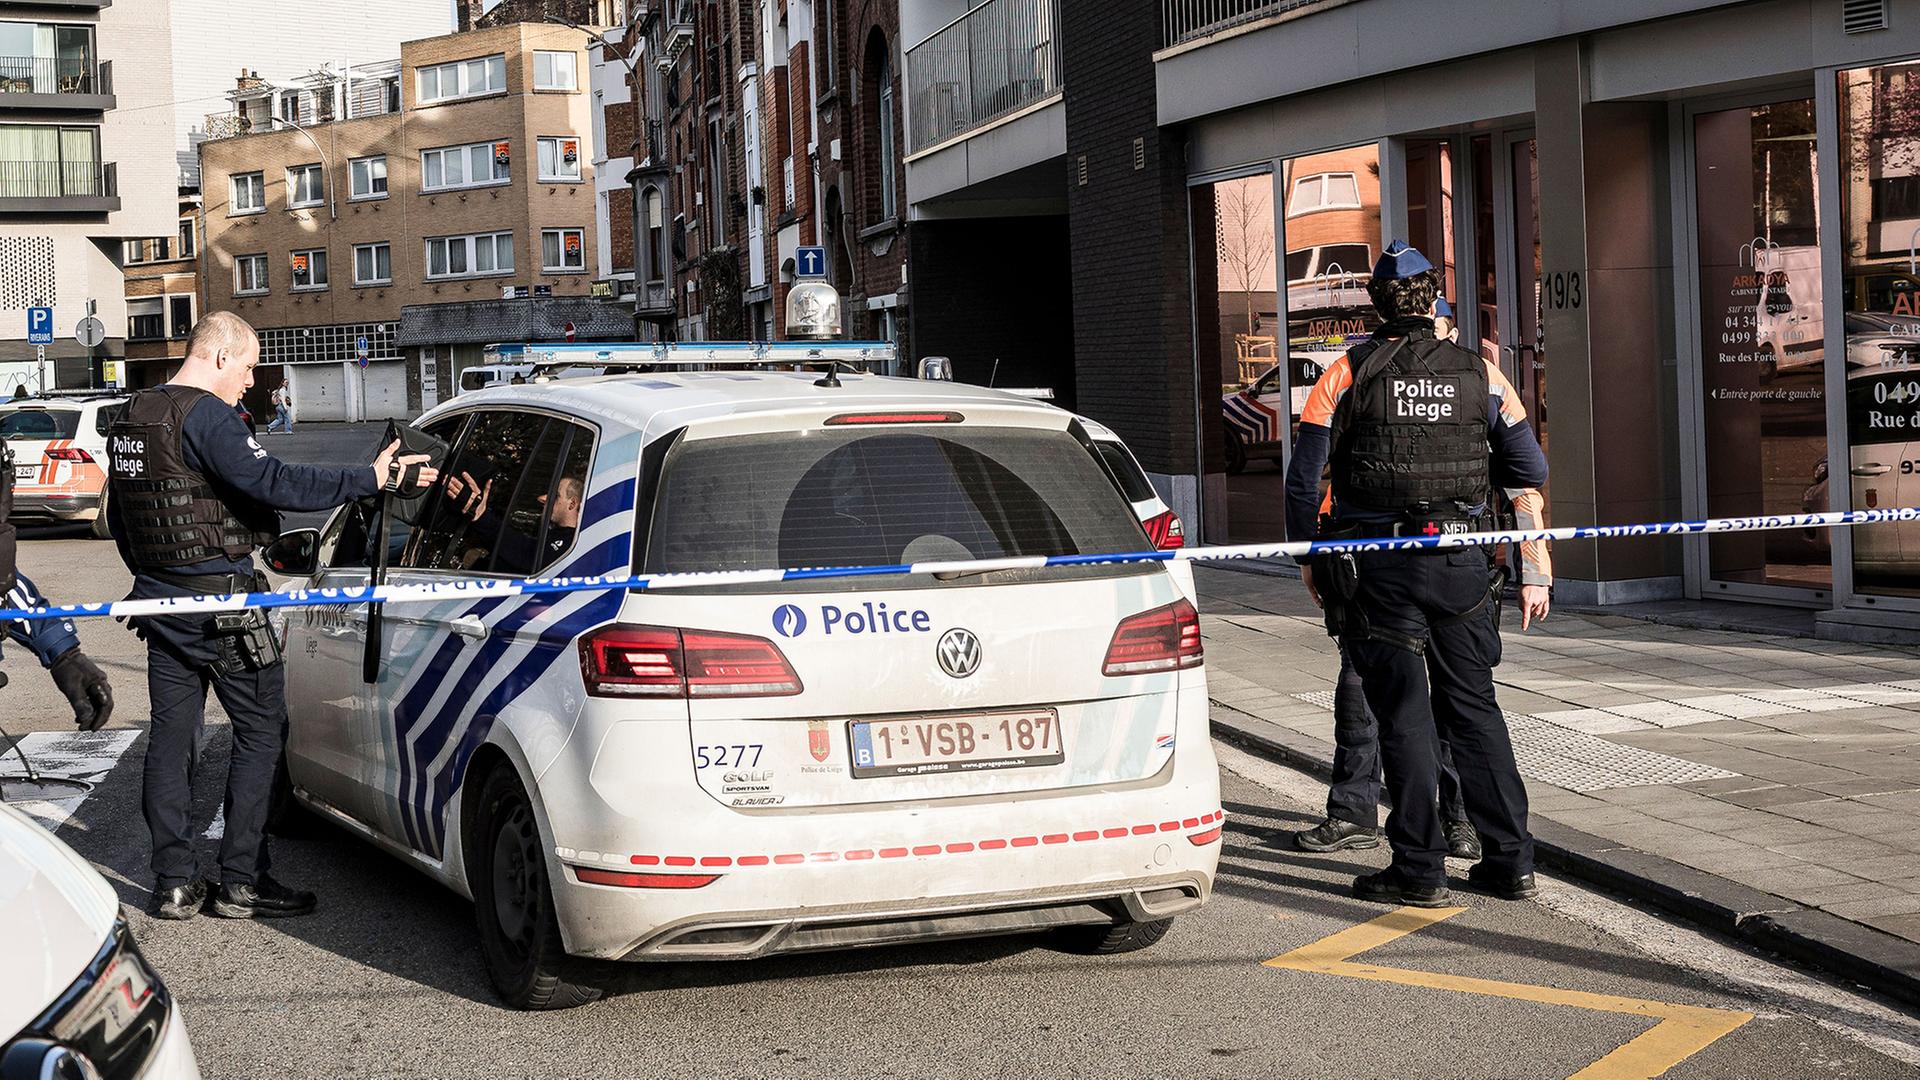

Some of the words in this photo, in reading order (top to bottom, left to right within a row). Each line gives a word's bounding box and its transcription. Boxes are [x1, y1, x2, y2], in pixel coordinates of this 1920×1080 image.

[1733, 274, 1790, 288] ARKADYA
[1545, 272, 1581, 309] 19/3
[33, 309, 47, 330] P
[1725, 316, 1739, 328] 04
[1308, 320, 1366, 337] ARKADYA
[1722, 331, 1751, 343] 0499
[1719, 353, 1736, 362] Rue
[1738, 353, 1752, 362] des
[1880, 350, 1909, 371] 04
[1303, 362, 1316, 379] 04
[1394, 380, 1455, 398] Police
[1720, 388, 1748, 399] Entrée
[1750, 390, 1774, 401] porte
[1775, 388, 1787, 399] de
[1788, 388, 1821, 401] gauche
[1398, 400, 1452, 421] Liege
[1869, 410, 1905, 428] Rue
[113, 436, 144, 453] Police
[114, 456, 143, 477] Liege
[1444, 523, 1468, 535] MED
[821, 602, 930, 635] Police
[878, 717, 1052, 760] 1-VSB-187
[697, 744, 763, 769] 5277
[858, 749, 870, 764] B
[723, 770, 774, 783] GOLF
